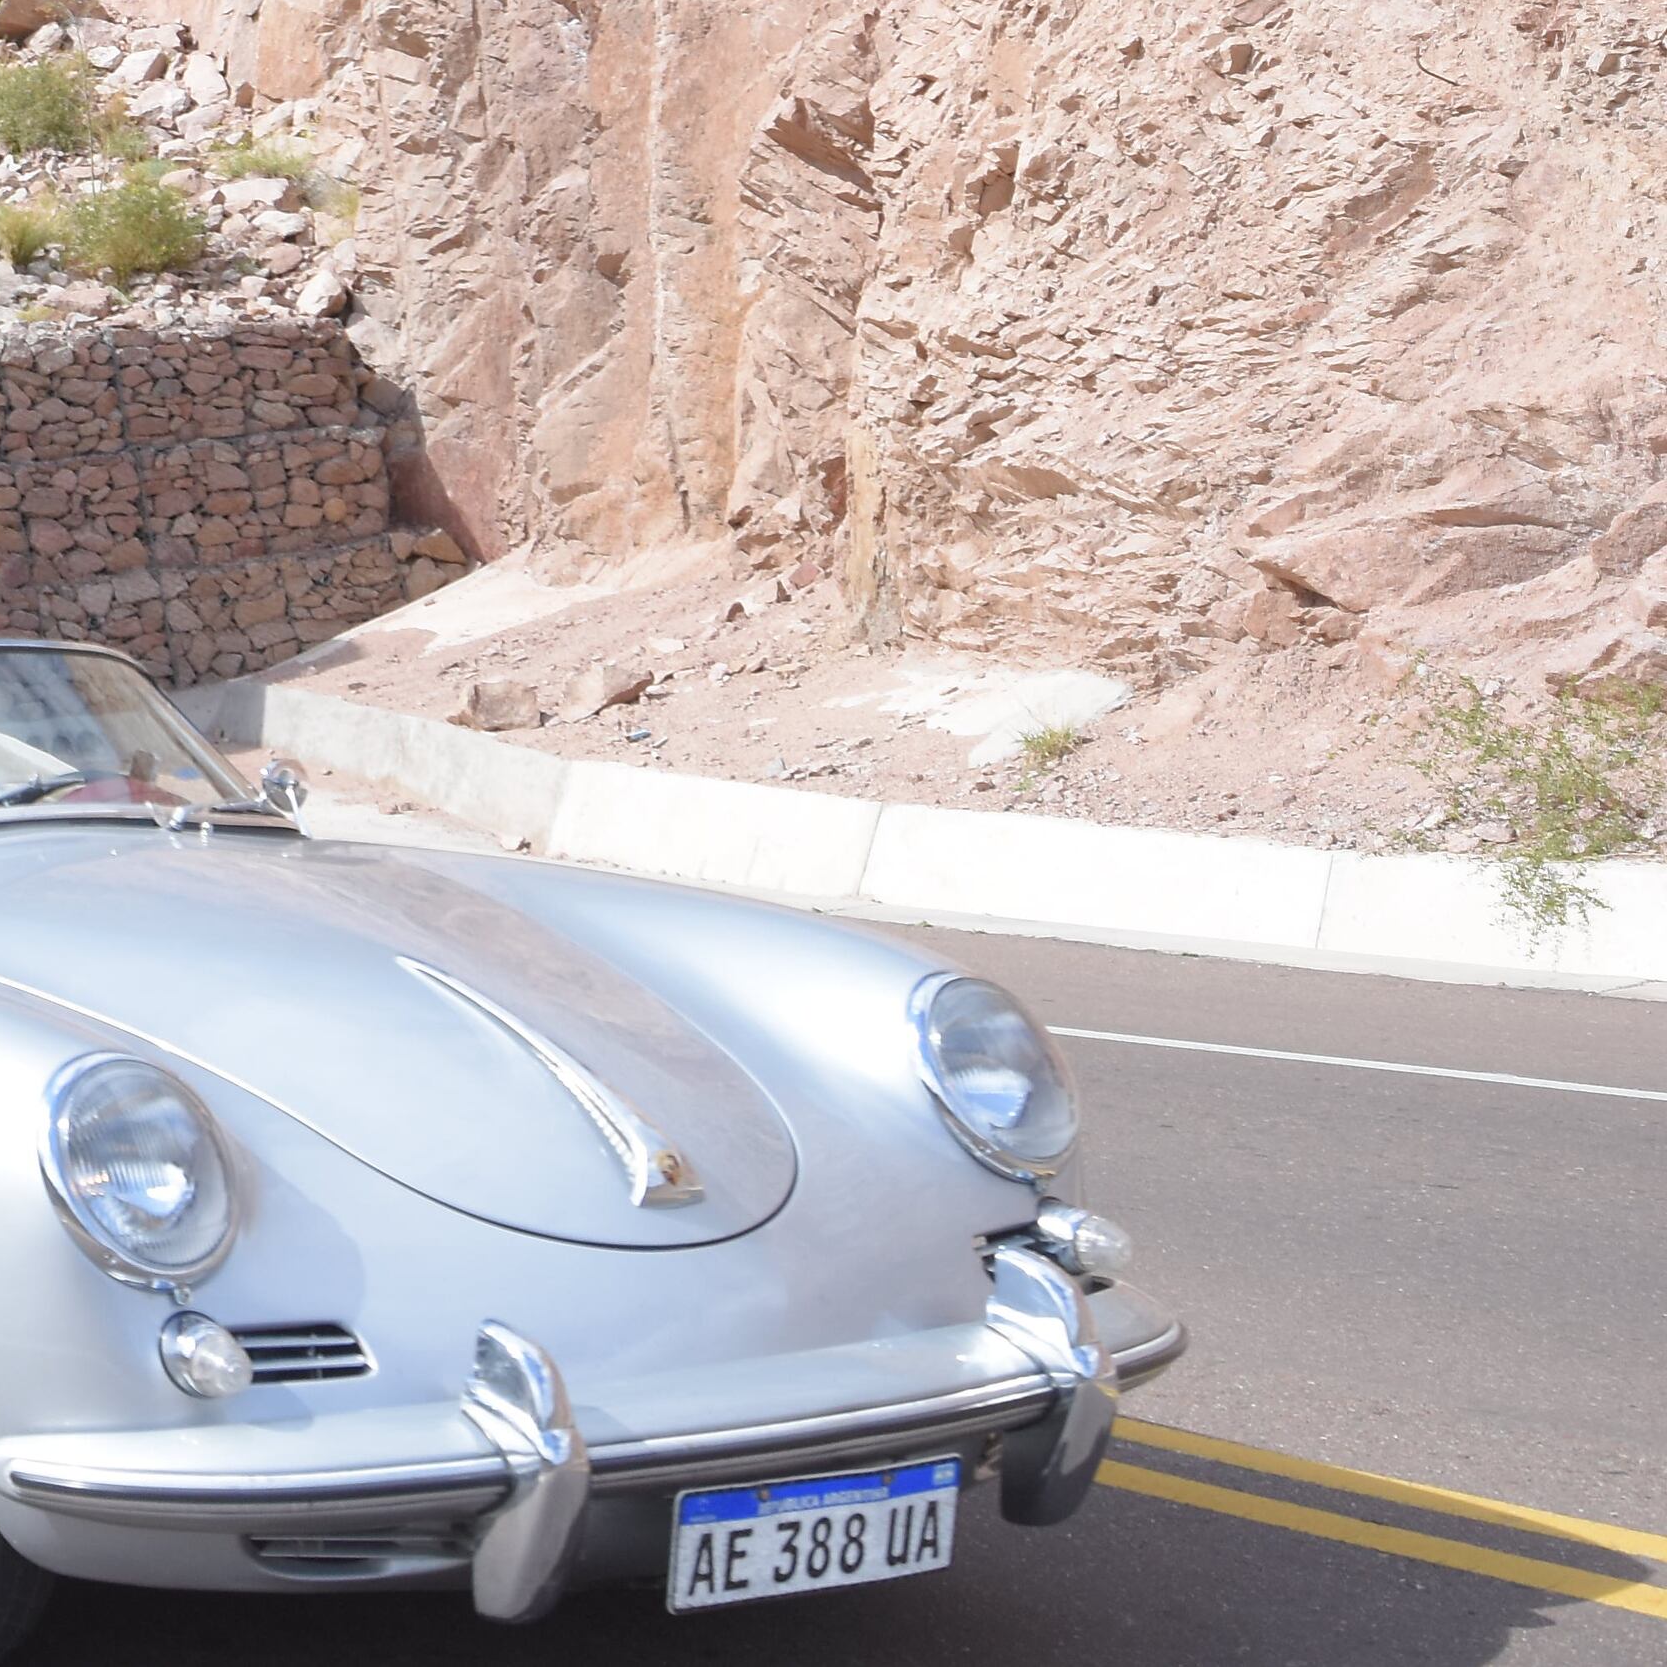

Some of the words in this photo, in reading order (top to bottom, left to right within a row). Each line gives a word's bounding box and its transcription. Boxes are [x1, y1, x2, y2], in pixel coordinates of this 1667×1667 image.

[688, 1528, 753, 1596] AE
[773, 1513, 866, 1583] 388
[886, 1501, 940, 1567] UA
